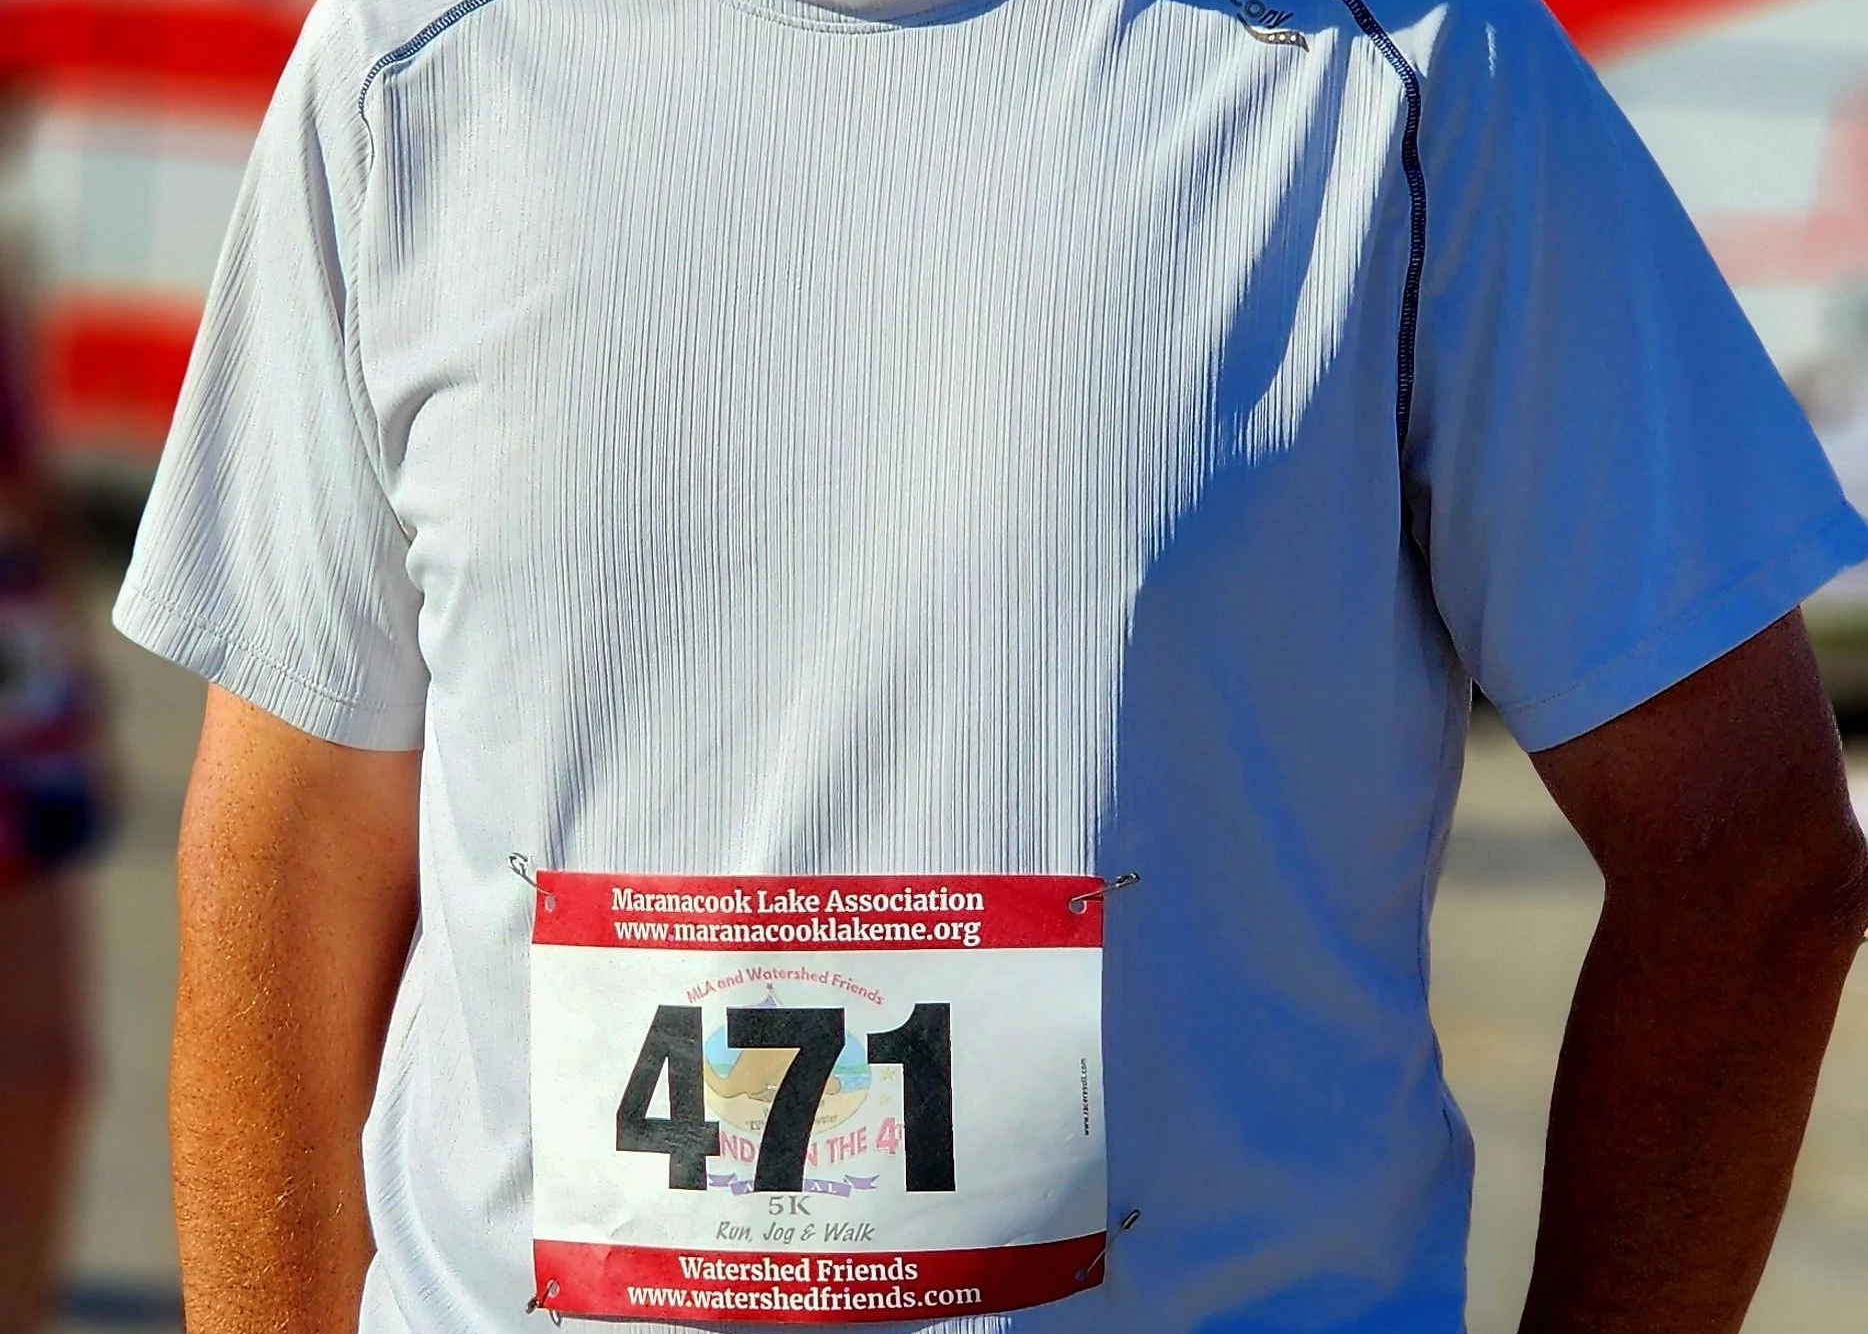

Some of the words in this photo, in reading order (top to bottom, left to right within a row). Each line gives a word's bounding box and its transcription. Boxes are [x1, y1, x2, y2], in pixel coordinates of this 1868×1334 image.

[611, 887, 753, 914] Maranacook
[757, 889, 819, 914] Lake
[825, 886, 984, 913] Association
[614, 917, 982, 946] www.maranacooklakeme.org
[686, 980, 716, 1003] MLA
[717, 970, 744, 990] and
[746, 966, 829, 984] Watershed
[831, 974, 885, 1005] Friends
[615, 1002, 957, 1193] 471
[826, 1126, 868, 1164] THE
[768, 1195, 811, 1216] 5K
[716, 1221, 752, 1243] Run,
[763, 1222, 795, 1245] Jog
[800, 1223, 816, 1241] &
[823, 1222, 875, 1242] Walk
[678, 1256, 810, 1282] Watershed
[816, 1257, 918, 1282] Friends
[627, 1285, 983, 1311] www.watershedfriends.com
